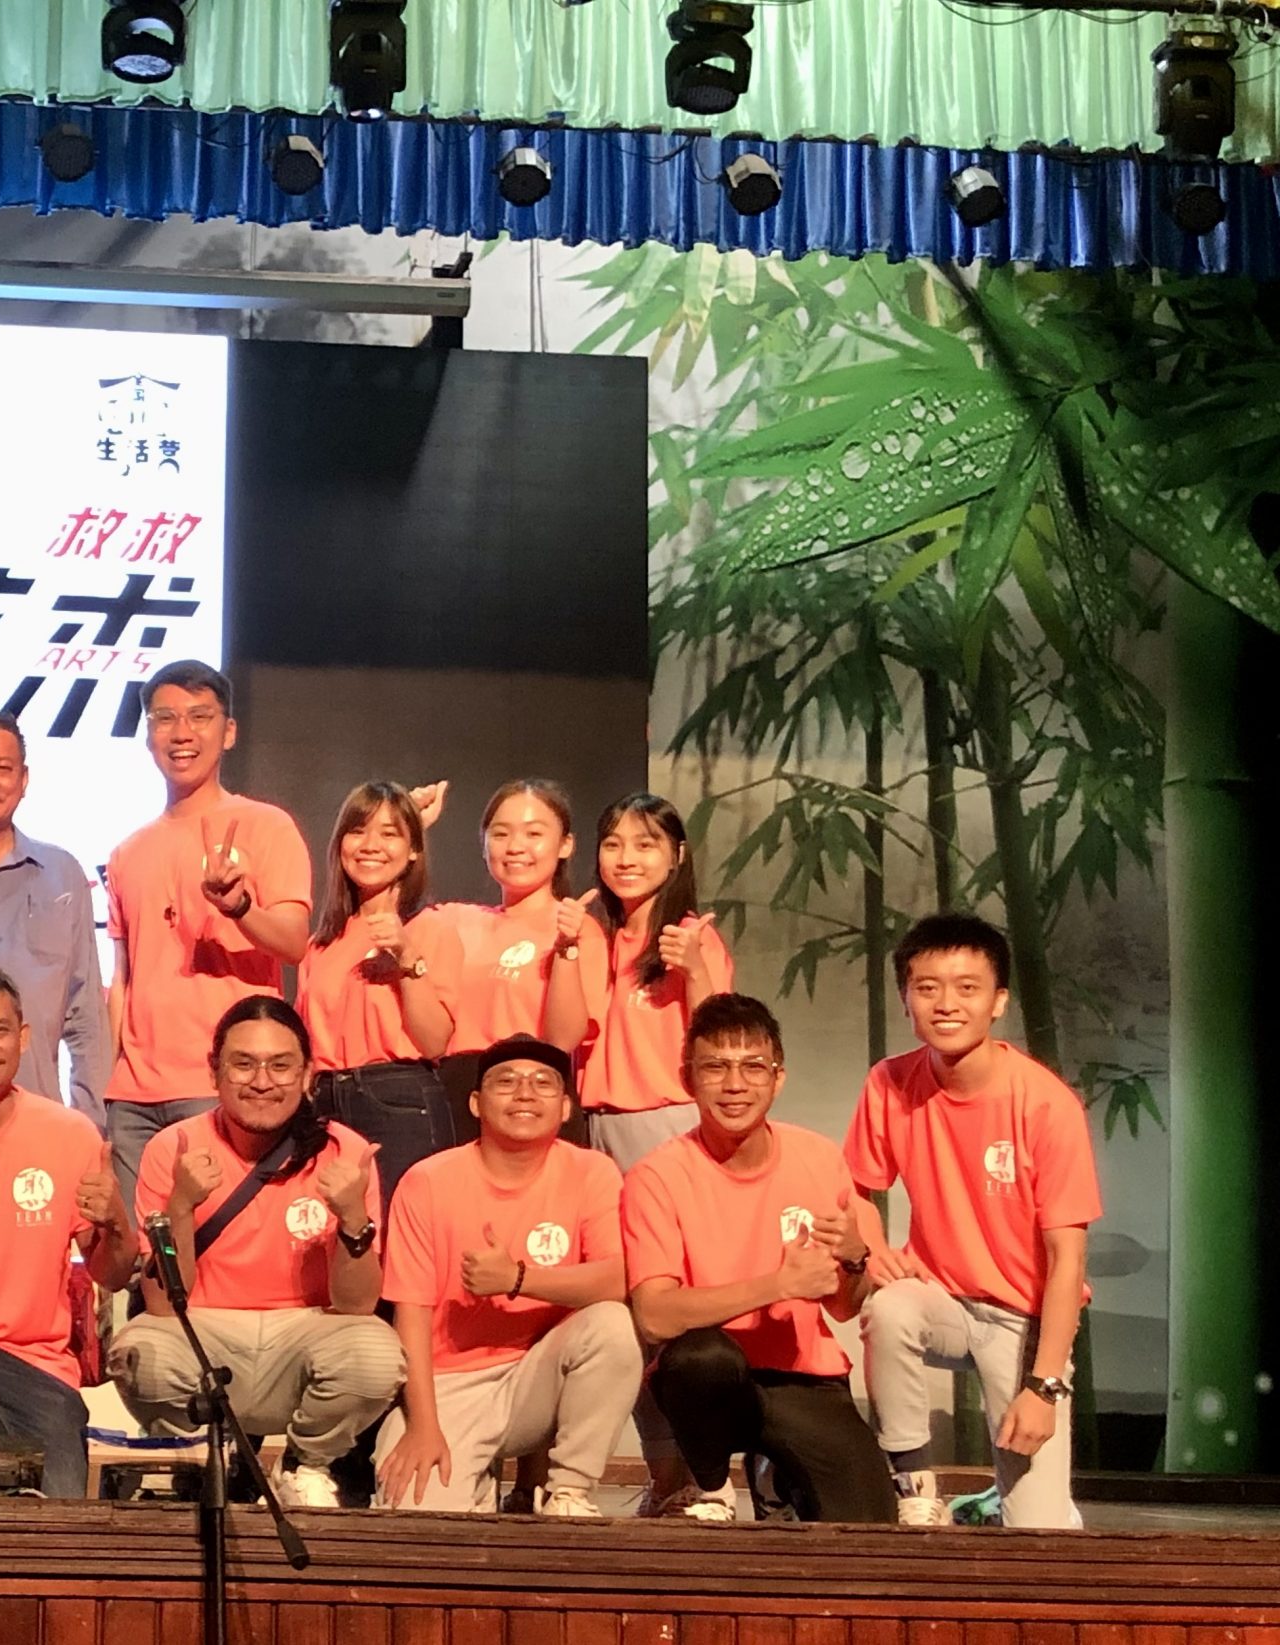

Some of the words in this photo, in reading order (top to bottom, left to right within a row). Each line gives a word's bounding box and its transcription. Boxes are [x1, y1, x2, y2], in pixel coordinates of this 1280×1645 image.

[96, 437, 181, 476] 生活营
[46, 507, 202, 564] 救救
[34, 647, 160, 674] ARTS
[15, 1210, 52, 1223] TEAM
